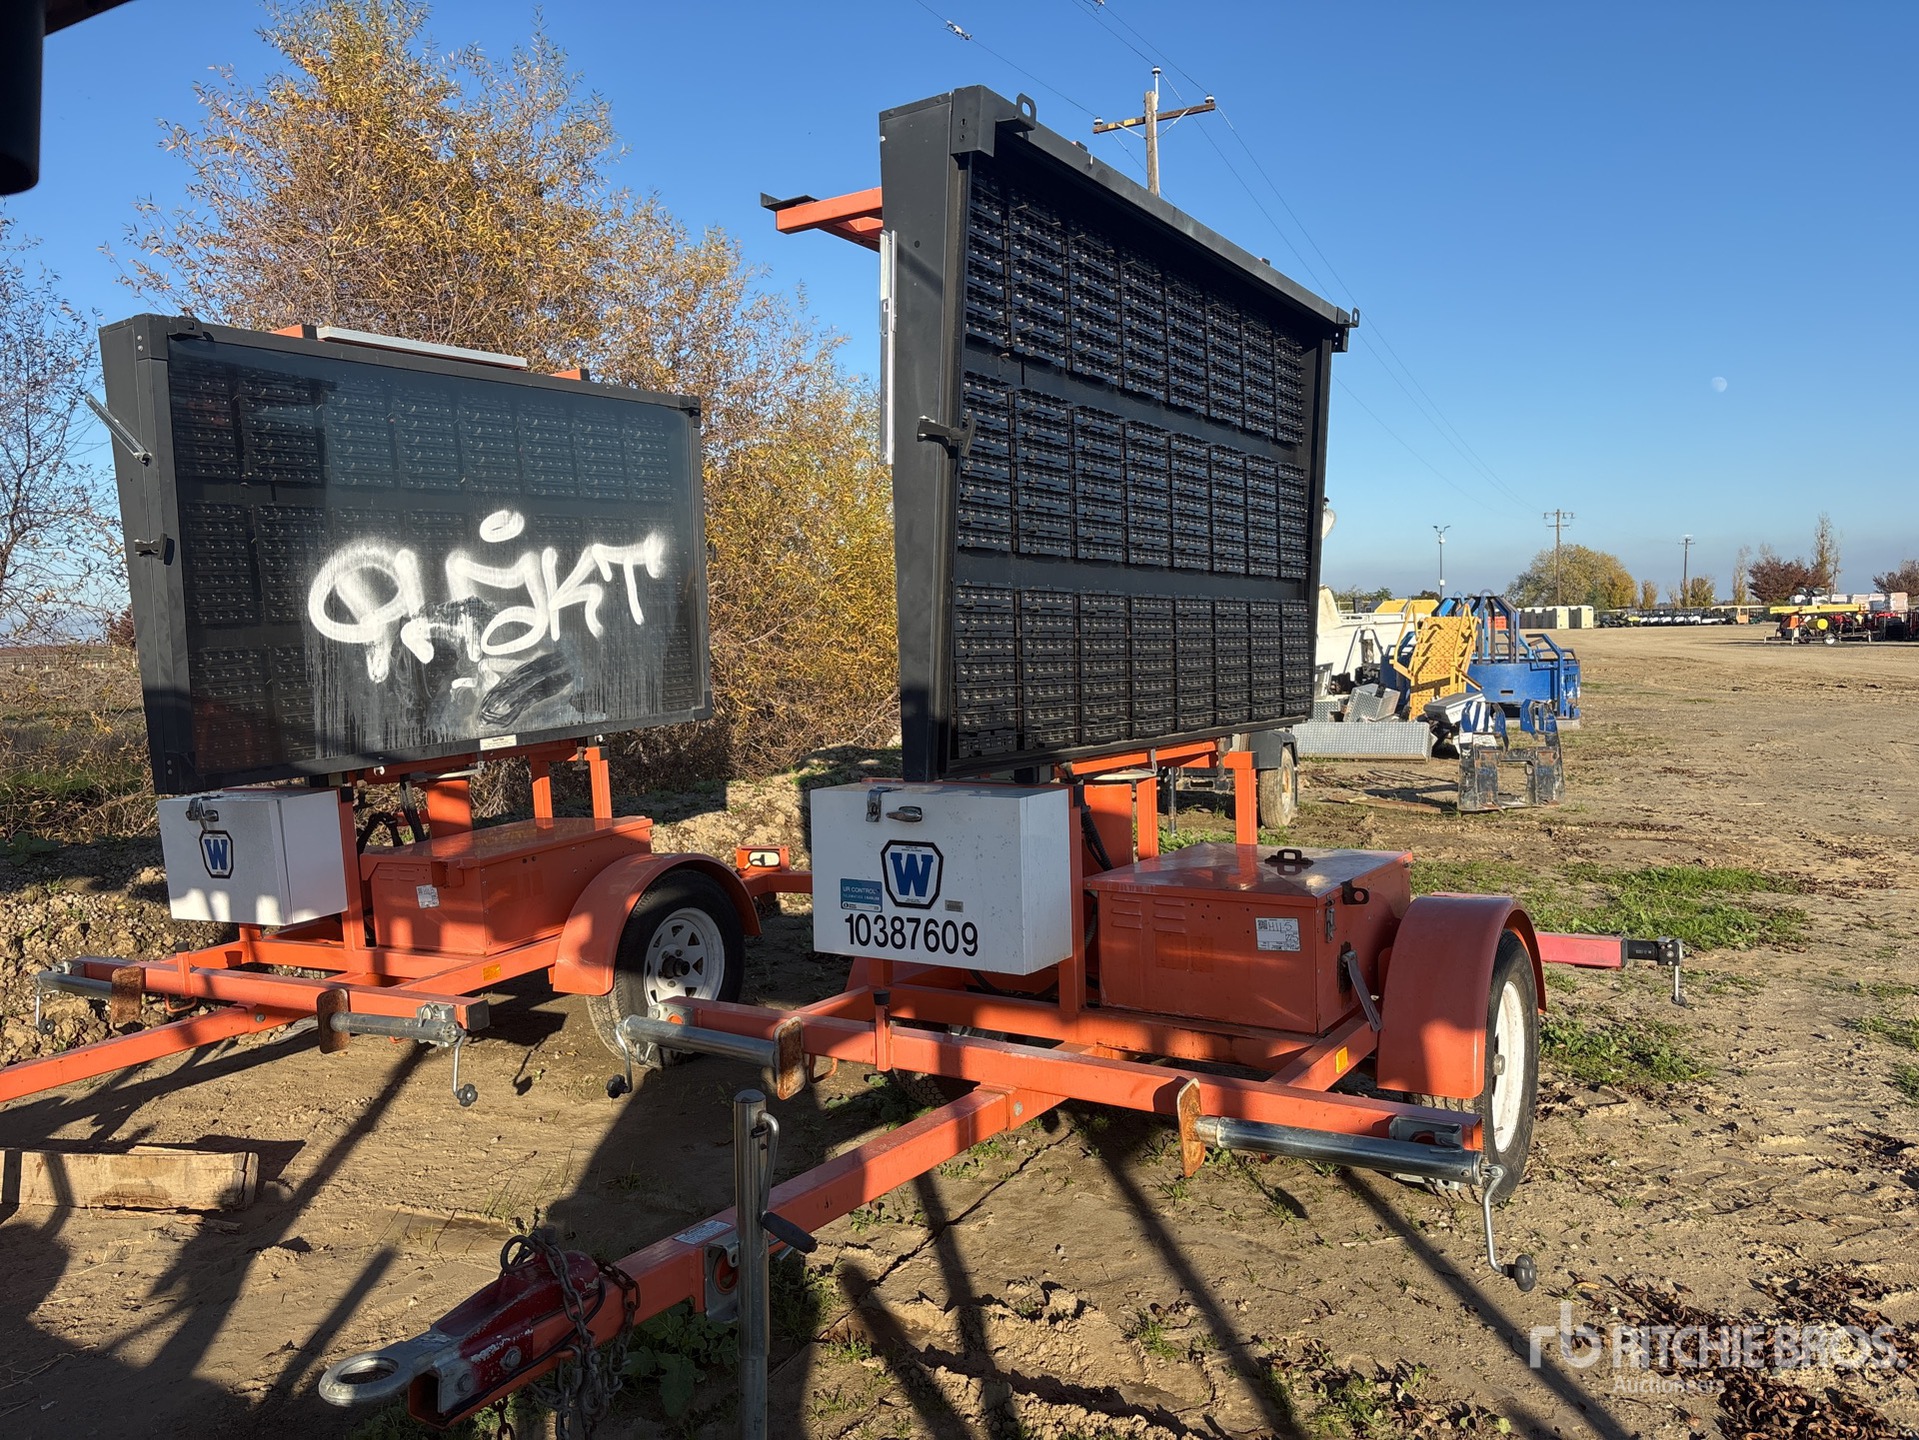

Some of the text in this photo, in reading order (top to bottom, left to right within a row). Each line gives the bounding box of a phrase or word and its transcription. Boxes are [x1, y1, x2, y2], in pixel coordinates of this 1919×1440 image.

[204, 839, 228, 870] W
[890, 852, 934, 897] W
[844, 912, 980, 957] 10387609
